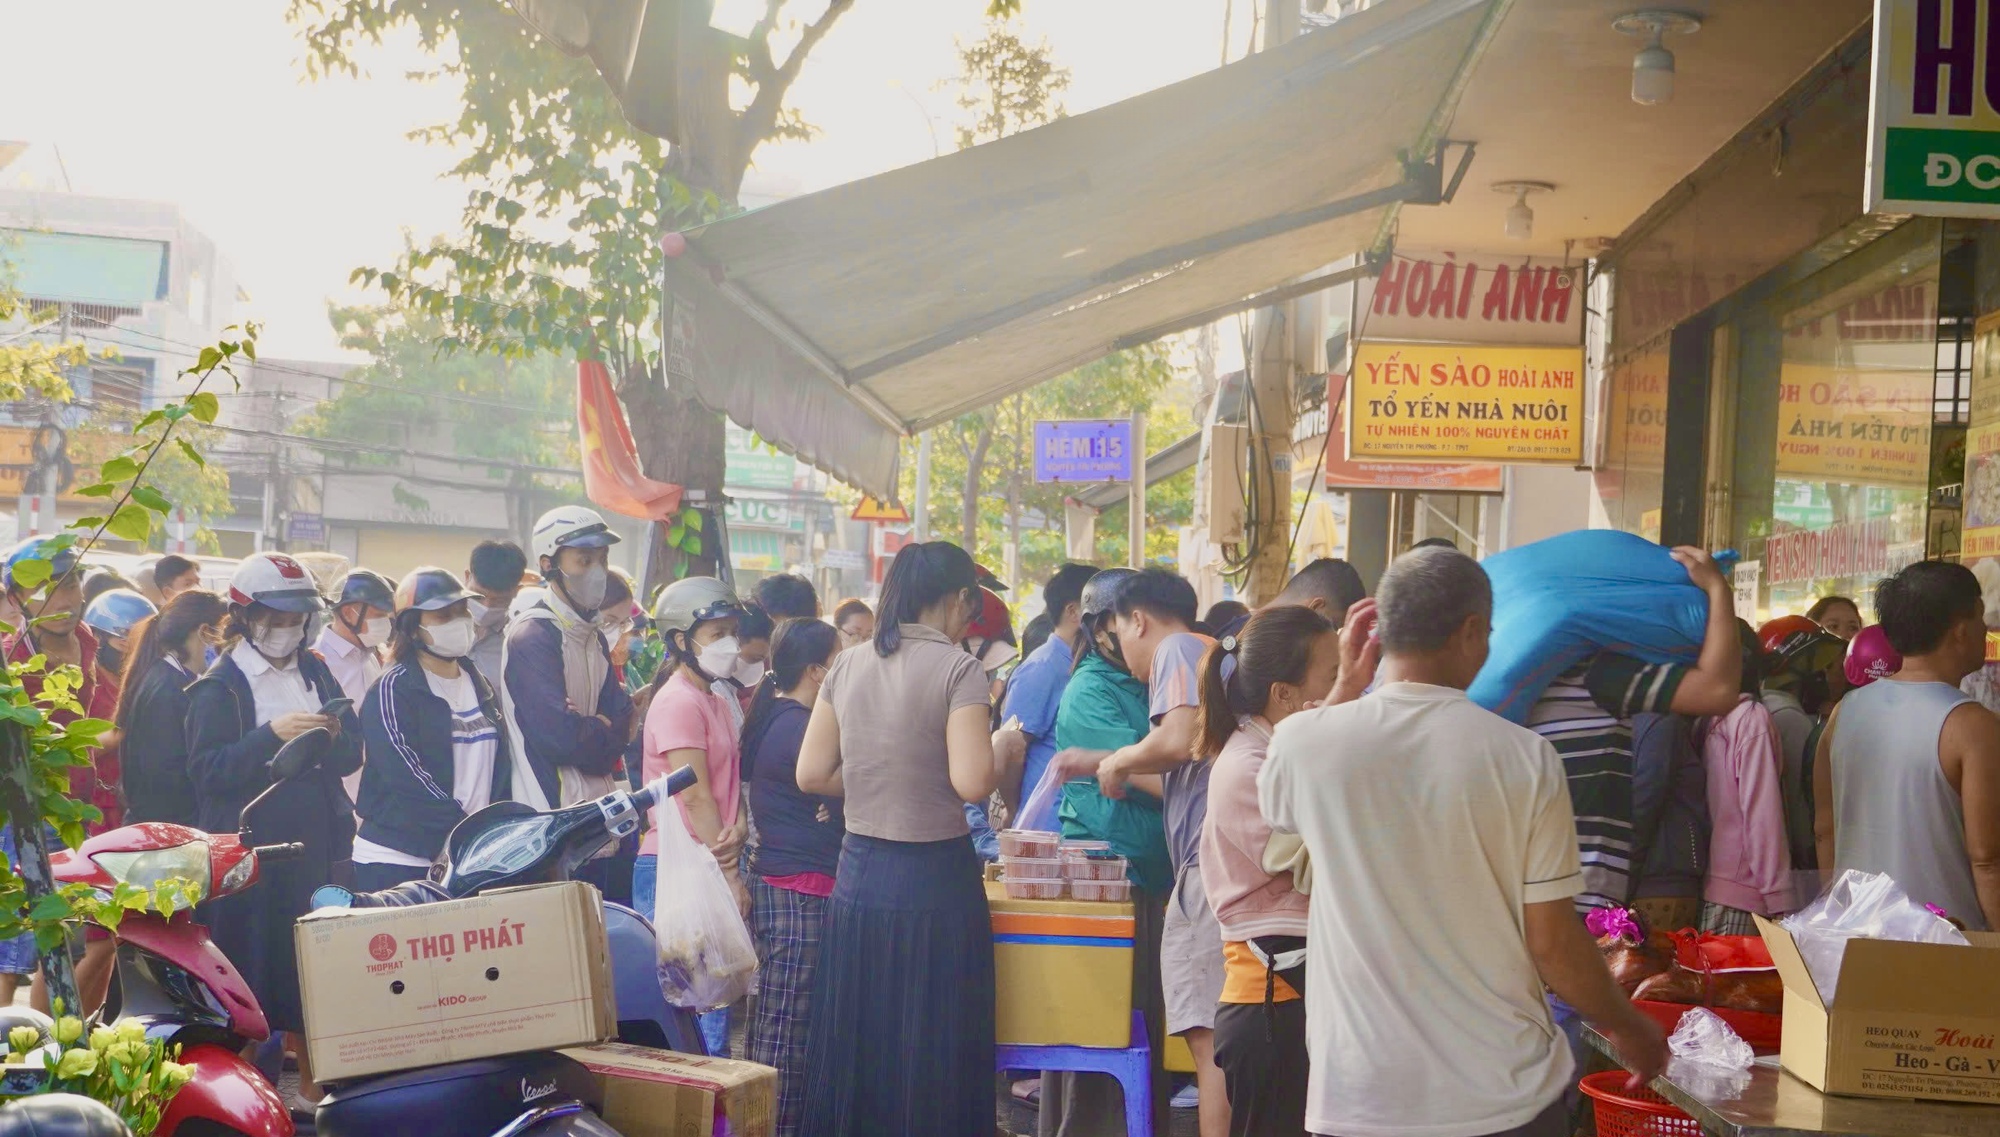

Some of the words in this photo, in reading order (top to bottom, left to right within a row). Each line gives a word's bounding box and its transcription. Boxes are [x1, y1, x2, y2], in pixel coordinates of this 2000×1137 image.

[1913, 0, 2000, 116] H
[1373, 251, 1477, 319] HOÀI
[1482, 262, 1574, 324] ANH
[1365, 351, 1420, 386] YẾN
[1430, 356, 1491, 388] SÀO
[1498, 364, 1536, 388] HOÀI
[1541, 370, 1574, 389] ANH
[1369, 389, 1398, 418] TỔ
[1405, 392, 1450, 419] YẾN
[1457, 397, 1504, 421] NHÀ
[1512, 398, 1568, 422] NUÔI
[1366, 424, 1384, 438] TỰ
[1389, 423, 1430, 437] NHIÊN
[1436, 426, 1470, 438] 100%
[1476, 425, 1530, 440] NGUYÊN
[1534, 424, 1570, 440] CHẤT
[1766, 523, 1791, 585] YẾN
[406, 933, 455, 963] THỌ
[464, 918, 526, 953] PHÁT
[366, 960, 404, 973] THOPHAT
[438, 995, 467, 1007] KIDO
[1866, 1026, 1889, 1036] HEO
[1891, 1028, 1921, 1039] QUAY
[1934, 1027, 1995, 1050] Hoài
[1895, 1052, 1929, 1069] Heo
[1946, 1056, 1970, 1072] Gà
[521, 1077, 557, 1103] Vespa
